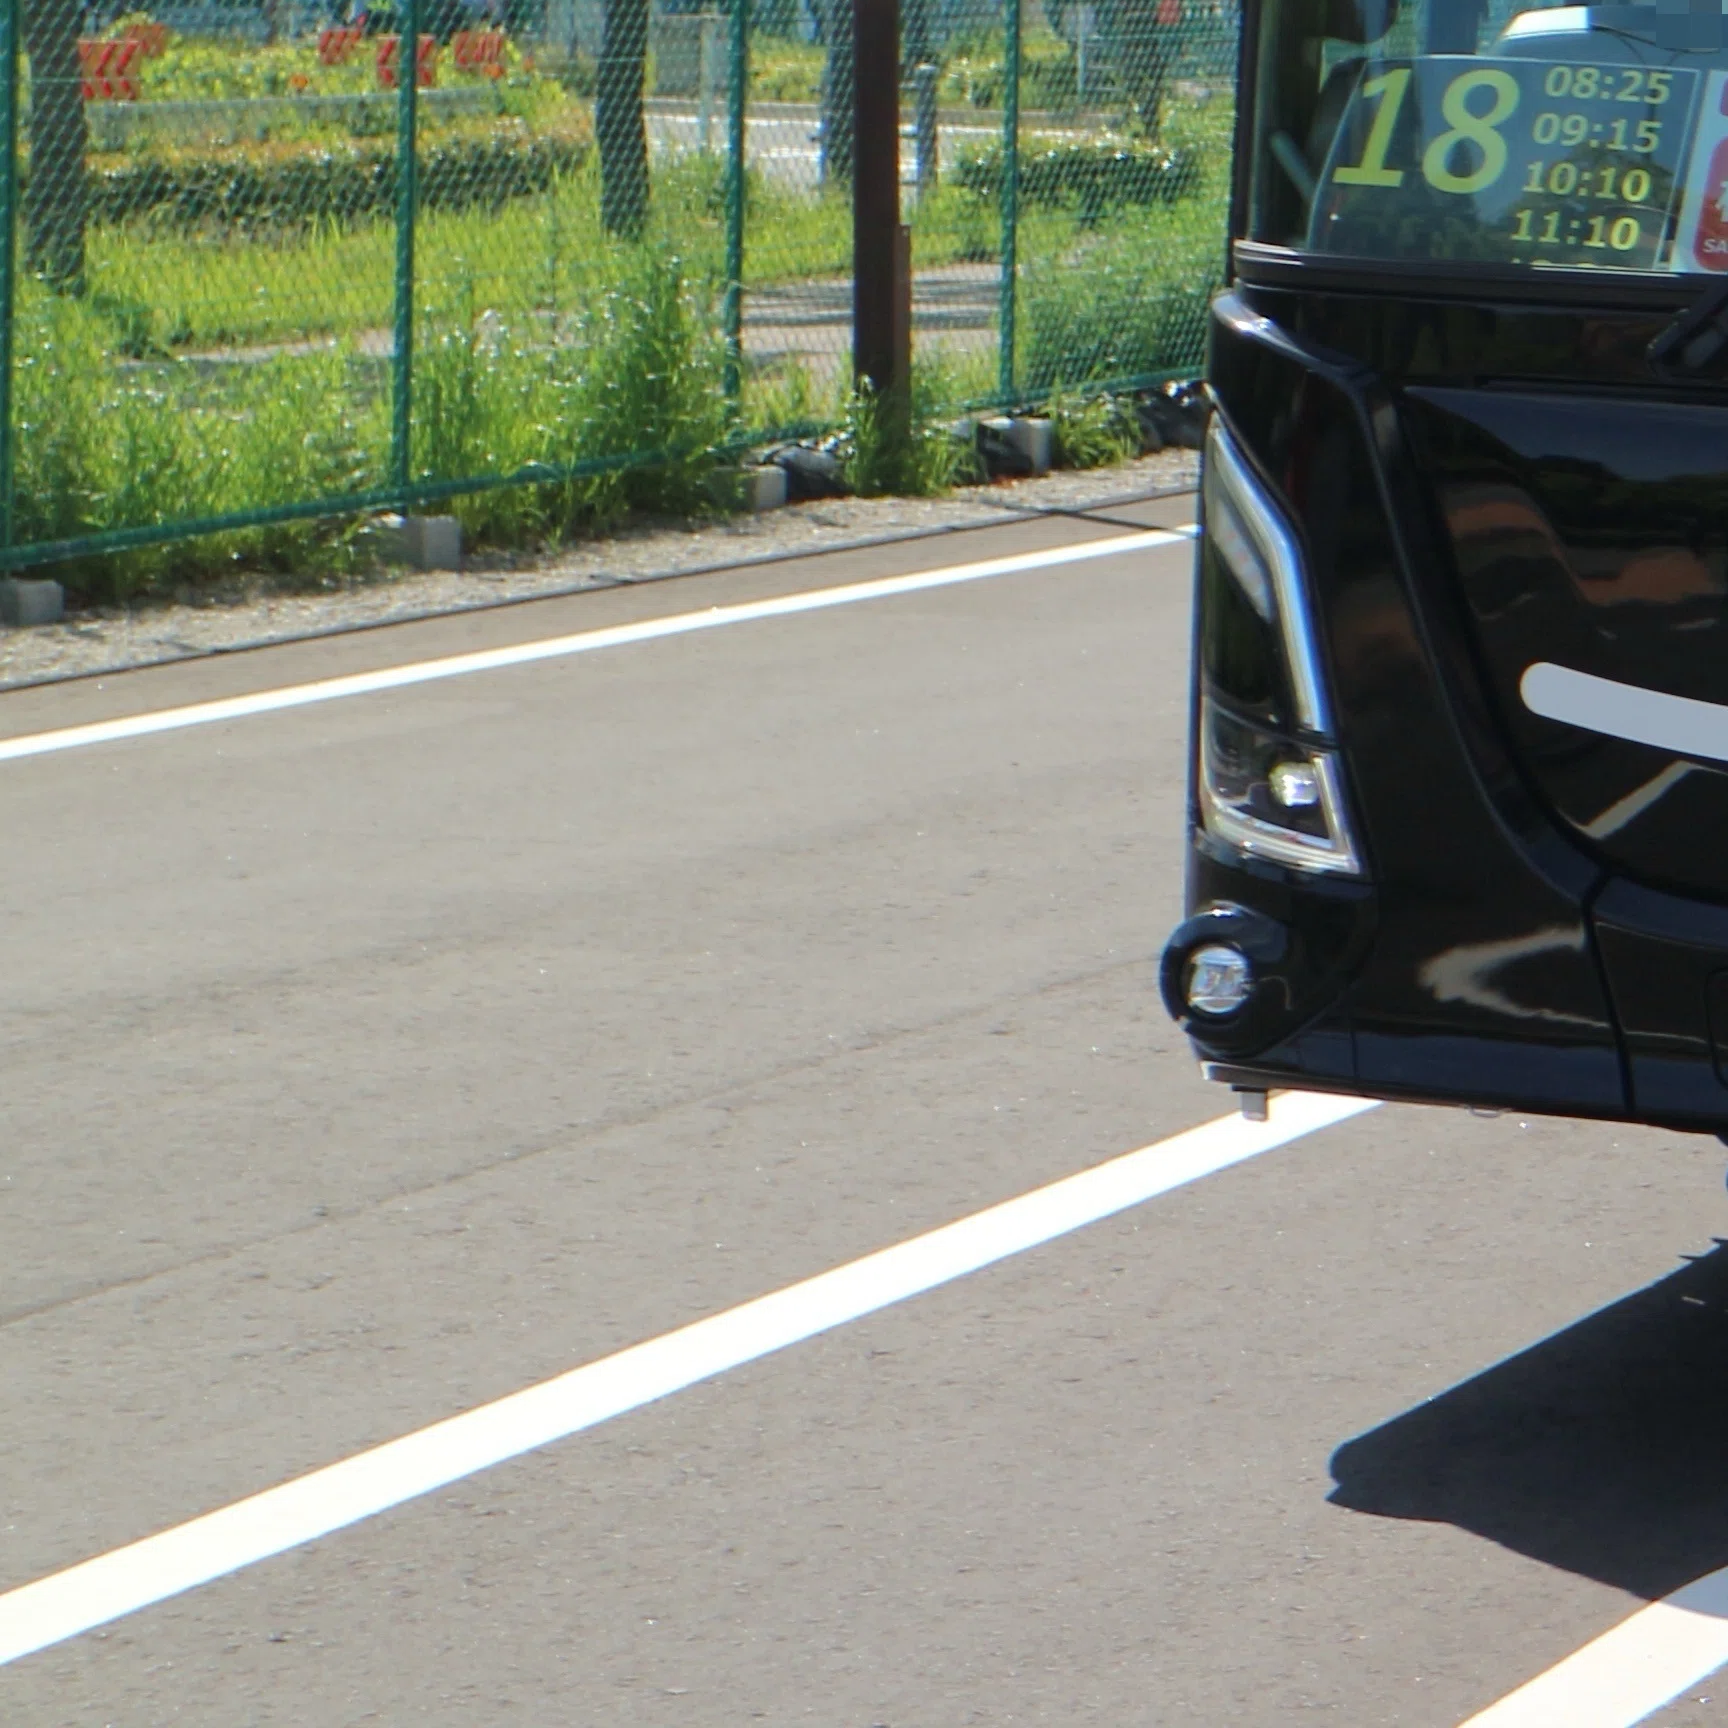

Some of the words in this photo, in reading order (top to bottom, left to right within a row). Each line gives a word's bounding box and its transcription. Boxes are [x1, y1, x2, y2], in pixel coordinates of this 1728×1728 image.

[1544, 65, 1675, 106] 08:25
[1333, 68, 1521, 195] 18
[1531, 112, 1664, 154] 09:15
[1522, 160, 1651, 203] 10:10
[1509, 208, 1641, 252] 11:10
